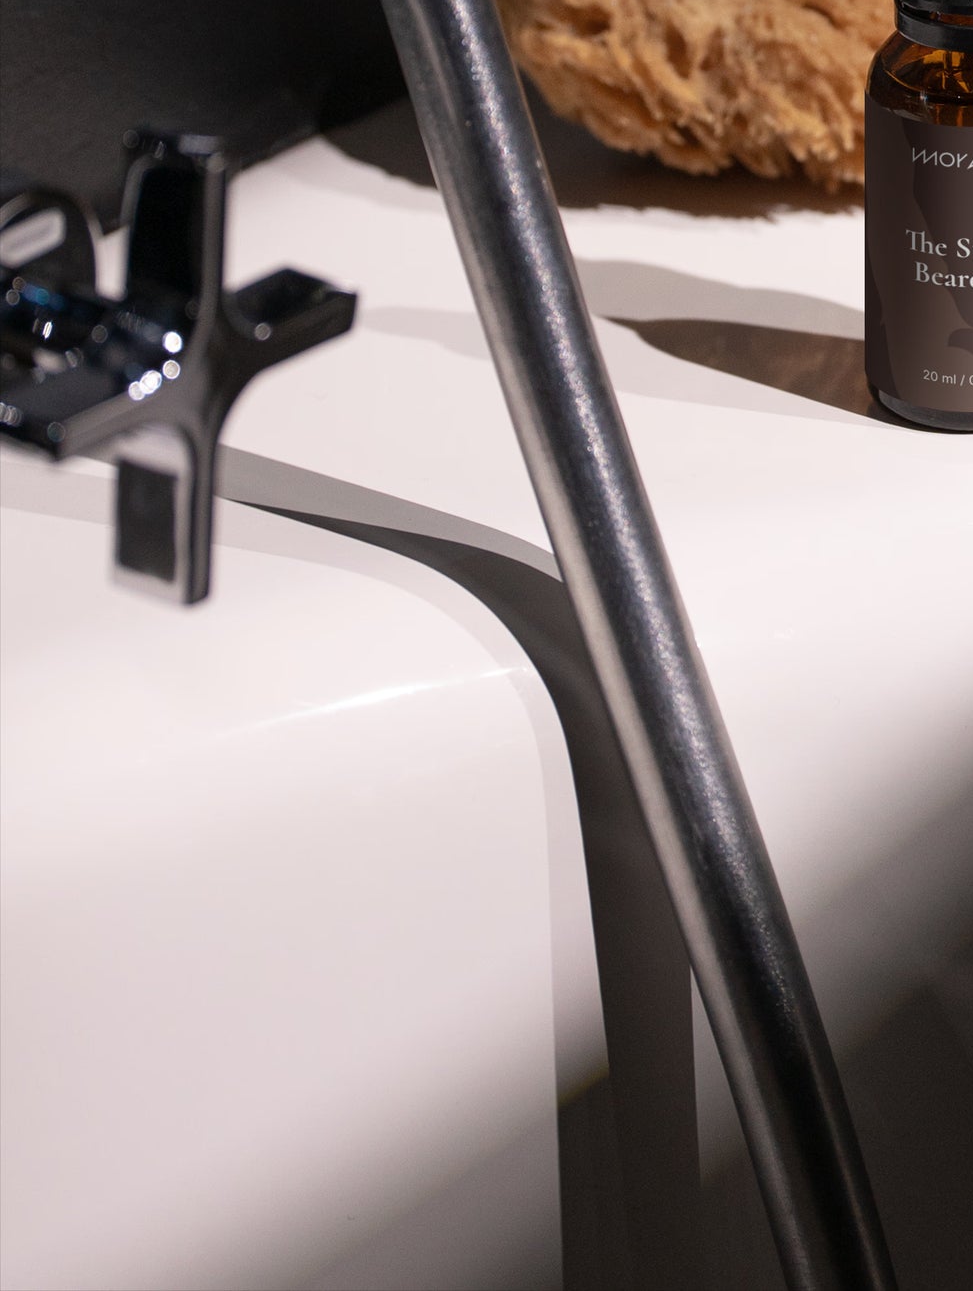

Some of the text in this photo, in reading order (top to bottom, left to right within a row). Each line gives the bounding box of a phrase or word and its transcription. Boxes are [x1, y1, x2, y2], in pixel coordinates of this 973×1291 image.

[905, 229, 947, 257] The
[923, 369, 938, 382] 20
[942, 374, 957, 384] ml
[960, 374, 965, 386] /
